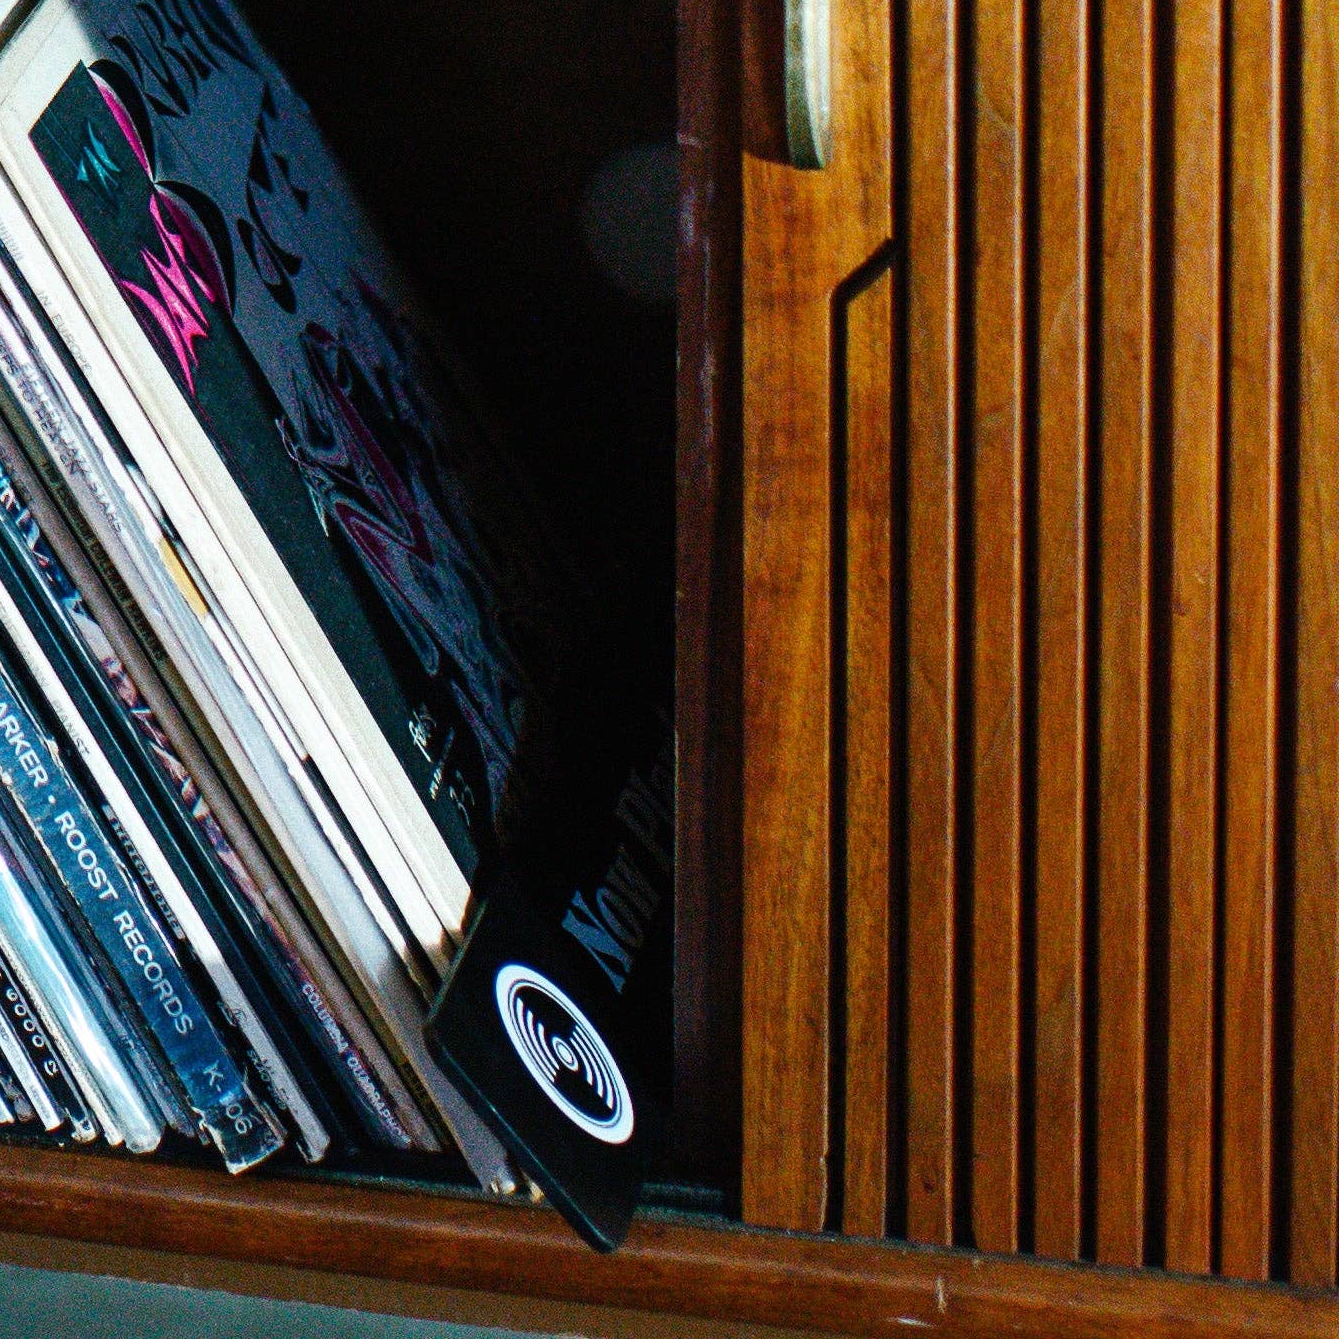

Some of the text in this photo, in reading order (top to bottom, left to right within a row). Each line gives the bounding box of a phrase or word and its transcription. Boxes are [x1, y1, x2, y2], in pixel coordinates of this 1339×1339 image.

[53, 809, 119, 905] ROOST
[112, 909, 195, 1035] RECORDS
[561, 843, 662, 995] Now
